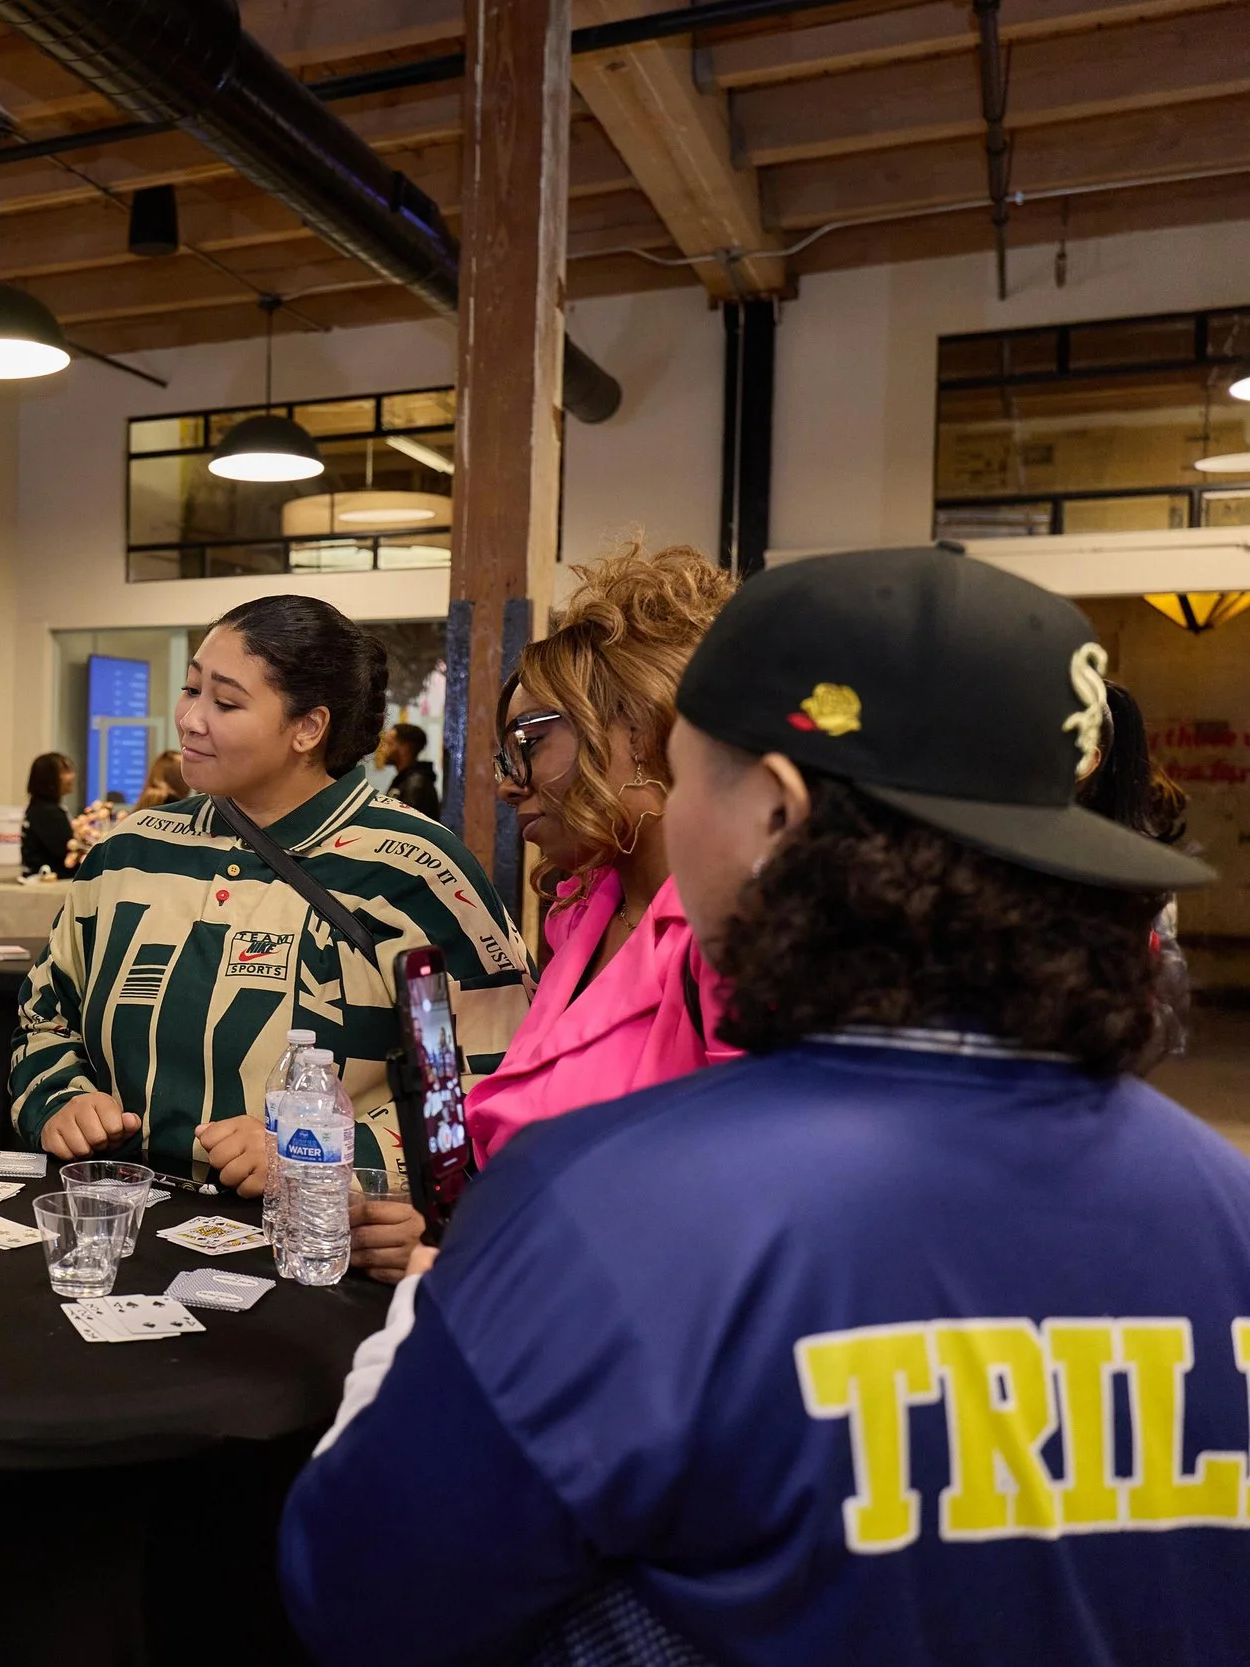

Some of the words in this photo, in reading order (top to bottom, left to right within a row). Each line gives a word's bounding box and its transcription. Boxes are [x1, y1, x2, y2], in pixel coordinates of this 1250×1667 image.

[137, 815, 175, 832] JUST
[374, 839, 419, 859] JUST
[414, 853, 442, 869] DO
[437, 868, 457, 886] IT
[239, 932, 290, 944] TEAM
[247, 941, 277, 954] NIKE
[480, 934, 515, 971] JUST
[230, 965, 282, 976] SPORTS
[288, 1144, 322, 1157] WATER
[794, 1317, 1250, 1554] TRIL
